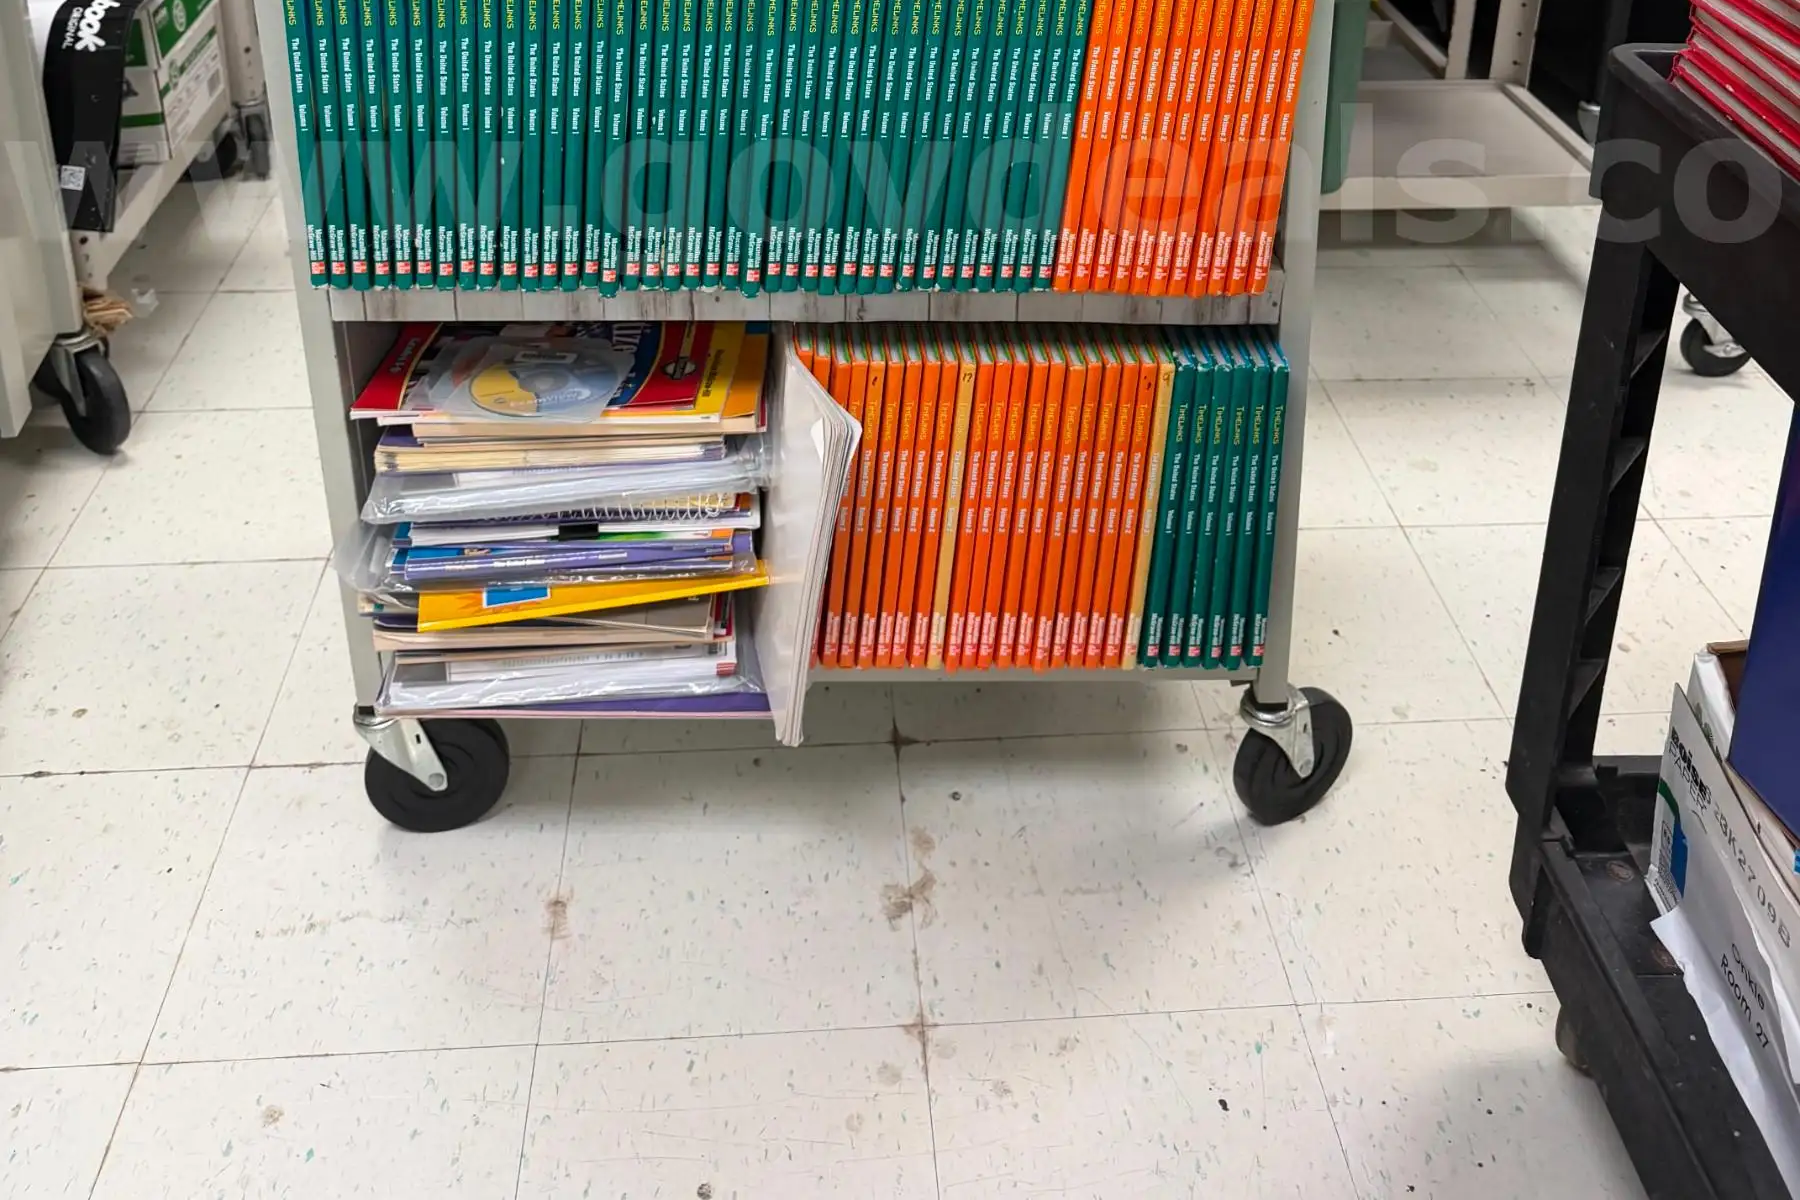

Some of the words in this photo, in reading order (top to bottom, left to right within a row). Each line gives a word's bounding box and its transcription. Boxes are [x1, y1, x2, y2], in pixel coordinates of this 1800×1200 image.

[62, 7, 84, 50] ORIGINAL
[1668, 740, 1707, 816] PAPER
[1720, 953, 1752, 1023] Room
[1756, 1022, 1769, 1048] 27
